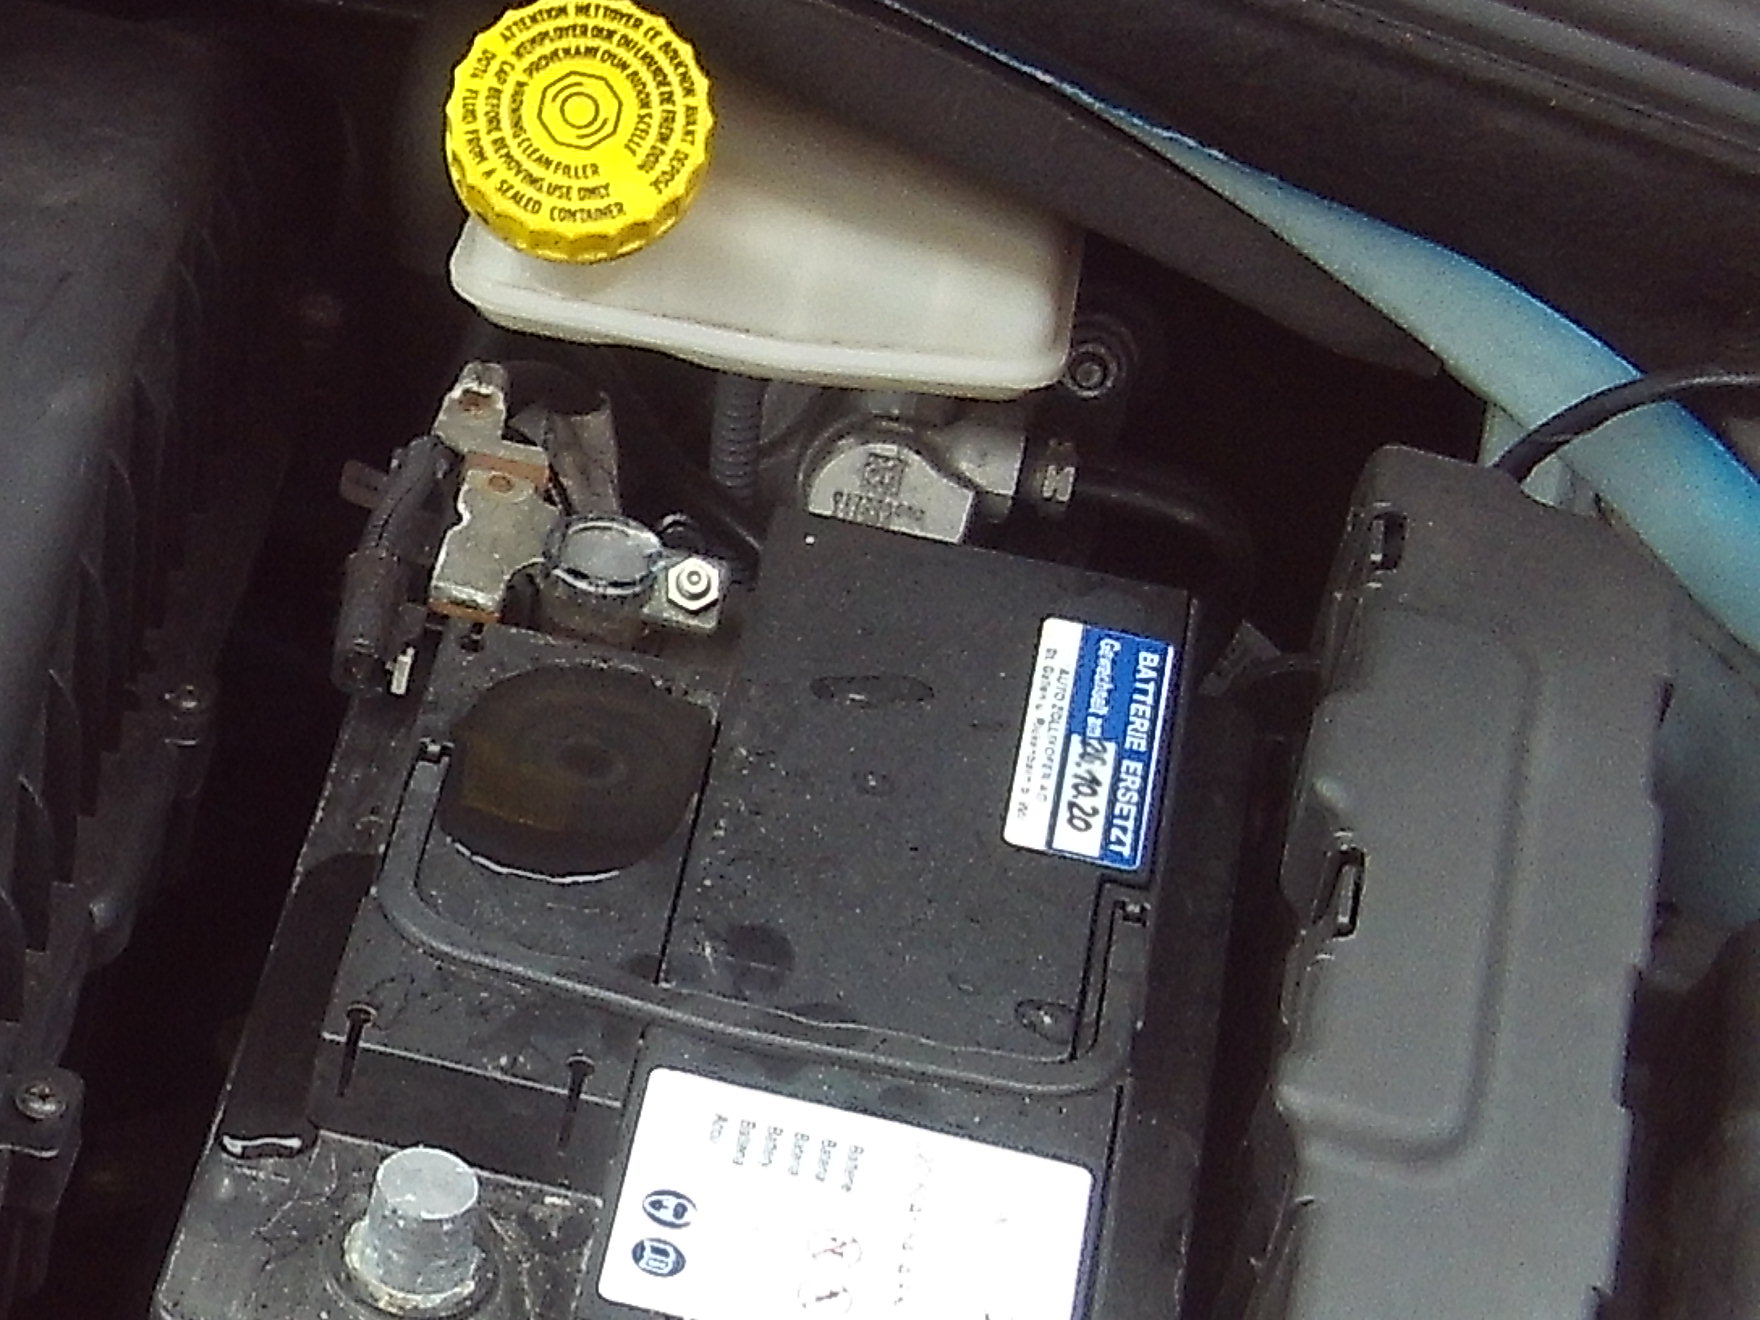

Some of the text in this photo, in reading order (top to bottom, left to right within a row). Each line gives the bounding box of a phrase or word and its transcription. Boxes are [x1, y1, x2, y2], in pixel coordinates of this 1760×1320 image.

[499, 5, 567, 43] ATTENTION
[482, 168, 498, 179] A
[494, 179, 542, 214] SEALED
[1054, 667, 1070, 701] AUTO
[1109, 651, 1159, 856] BATTERIE ERSETZT
